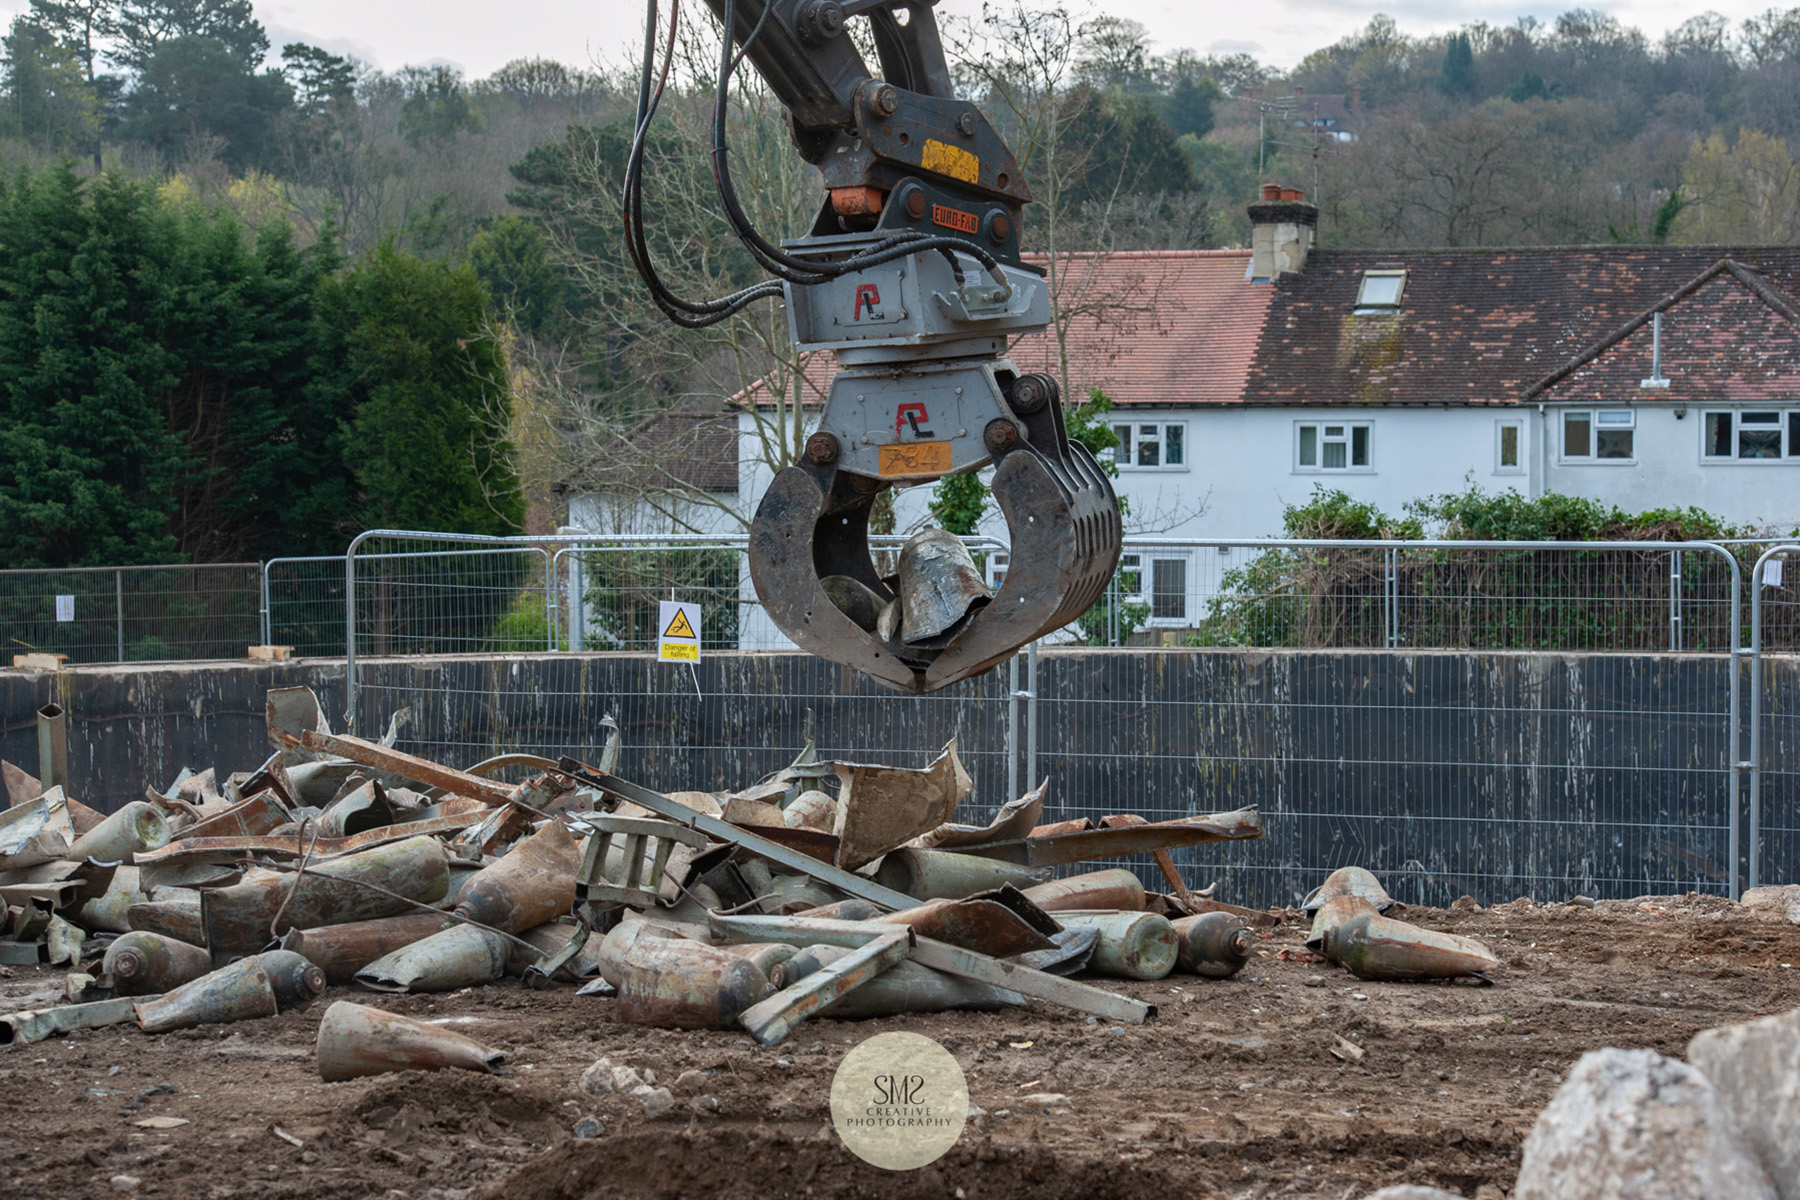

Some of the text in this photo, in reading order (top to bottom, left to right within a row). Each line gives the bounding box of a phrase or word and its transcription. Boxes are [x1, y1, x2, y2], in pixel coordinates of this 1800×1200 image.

[935, 207, 976, 232] EURO-FAB
[664, 644, 688, 652] Danger
[670, 651, 690, 659] falling
